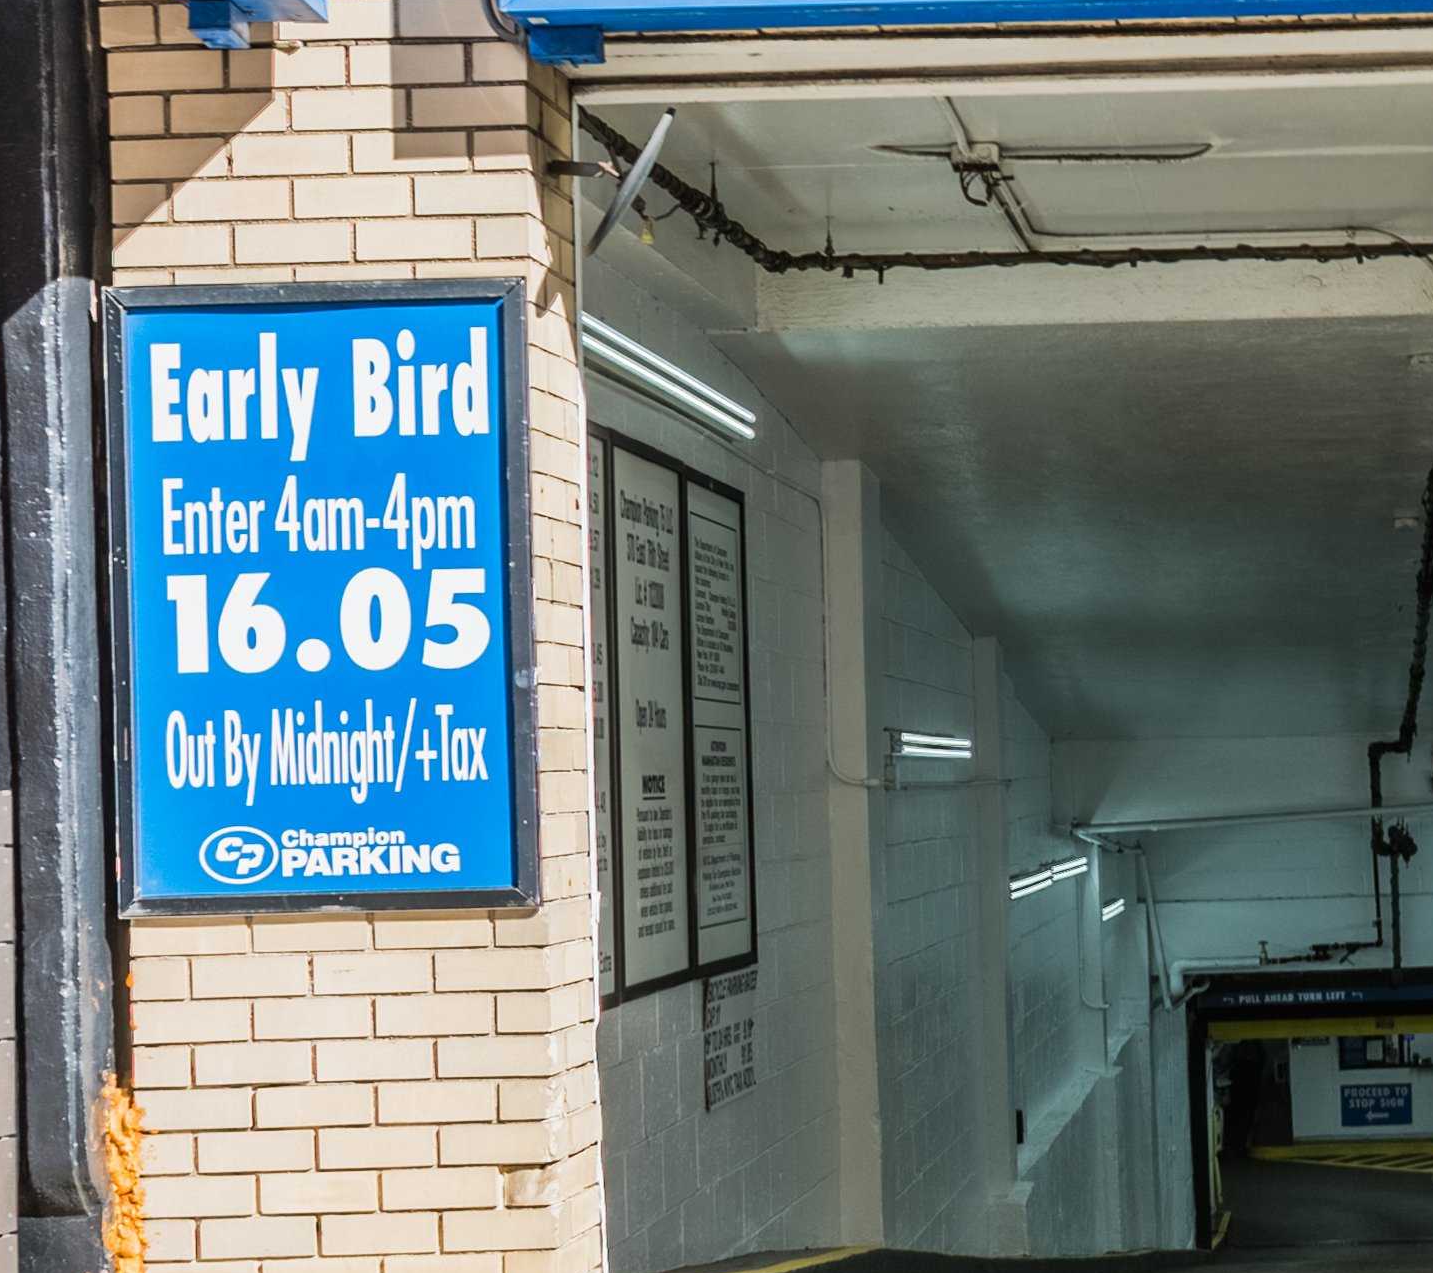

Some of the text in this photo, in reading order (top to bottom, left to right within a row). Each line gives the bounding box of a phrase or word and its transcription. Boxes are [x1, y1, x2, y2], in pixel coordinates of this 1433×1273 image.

[149, 326, 491, 462] Early Bird
[161, 472, 477, 571] Enter 4am-4pm
[166, 566, 492, 675] 16.05
[166, 709, 217, 790] Out
[223, 708, 262, 807] By
[281, 827, 406, 848] Champion
[281, 841, 461, 878] PARKING
[1238, 991, 1346, 1005] PULL AHEAD TURN LEFT
[1343, 1086, 1408, 1097] PROCEED TO
[1349, 1097, 1405, 1109] STOP SIGN
